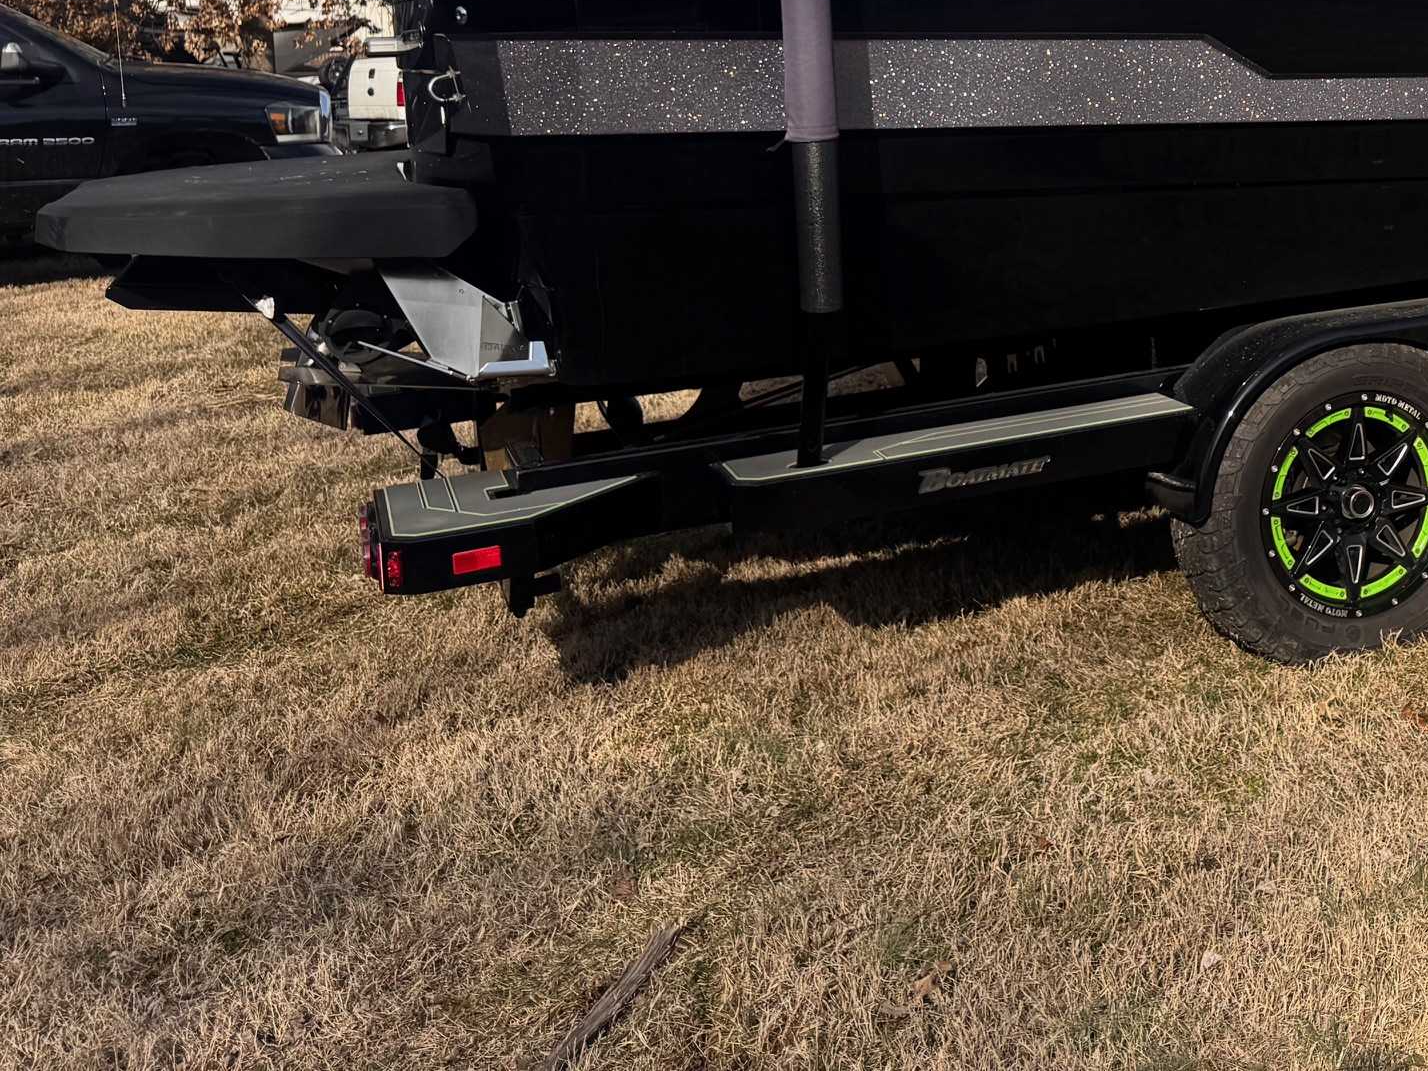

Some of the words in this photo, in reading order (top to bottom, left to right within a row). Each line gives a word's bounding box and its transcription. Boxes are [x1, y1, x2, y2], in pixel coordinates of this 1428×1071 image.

[42, 137, 95, 146] 2500
[1375, 393, 1398, 406] MOTO
[1398, 401, 1422, 420] METAL
[1299, 593, 1326, 614] METAL
[1325, 607, 1349, 618] MOTO
